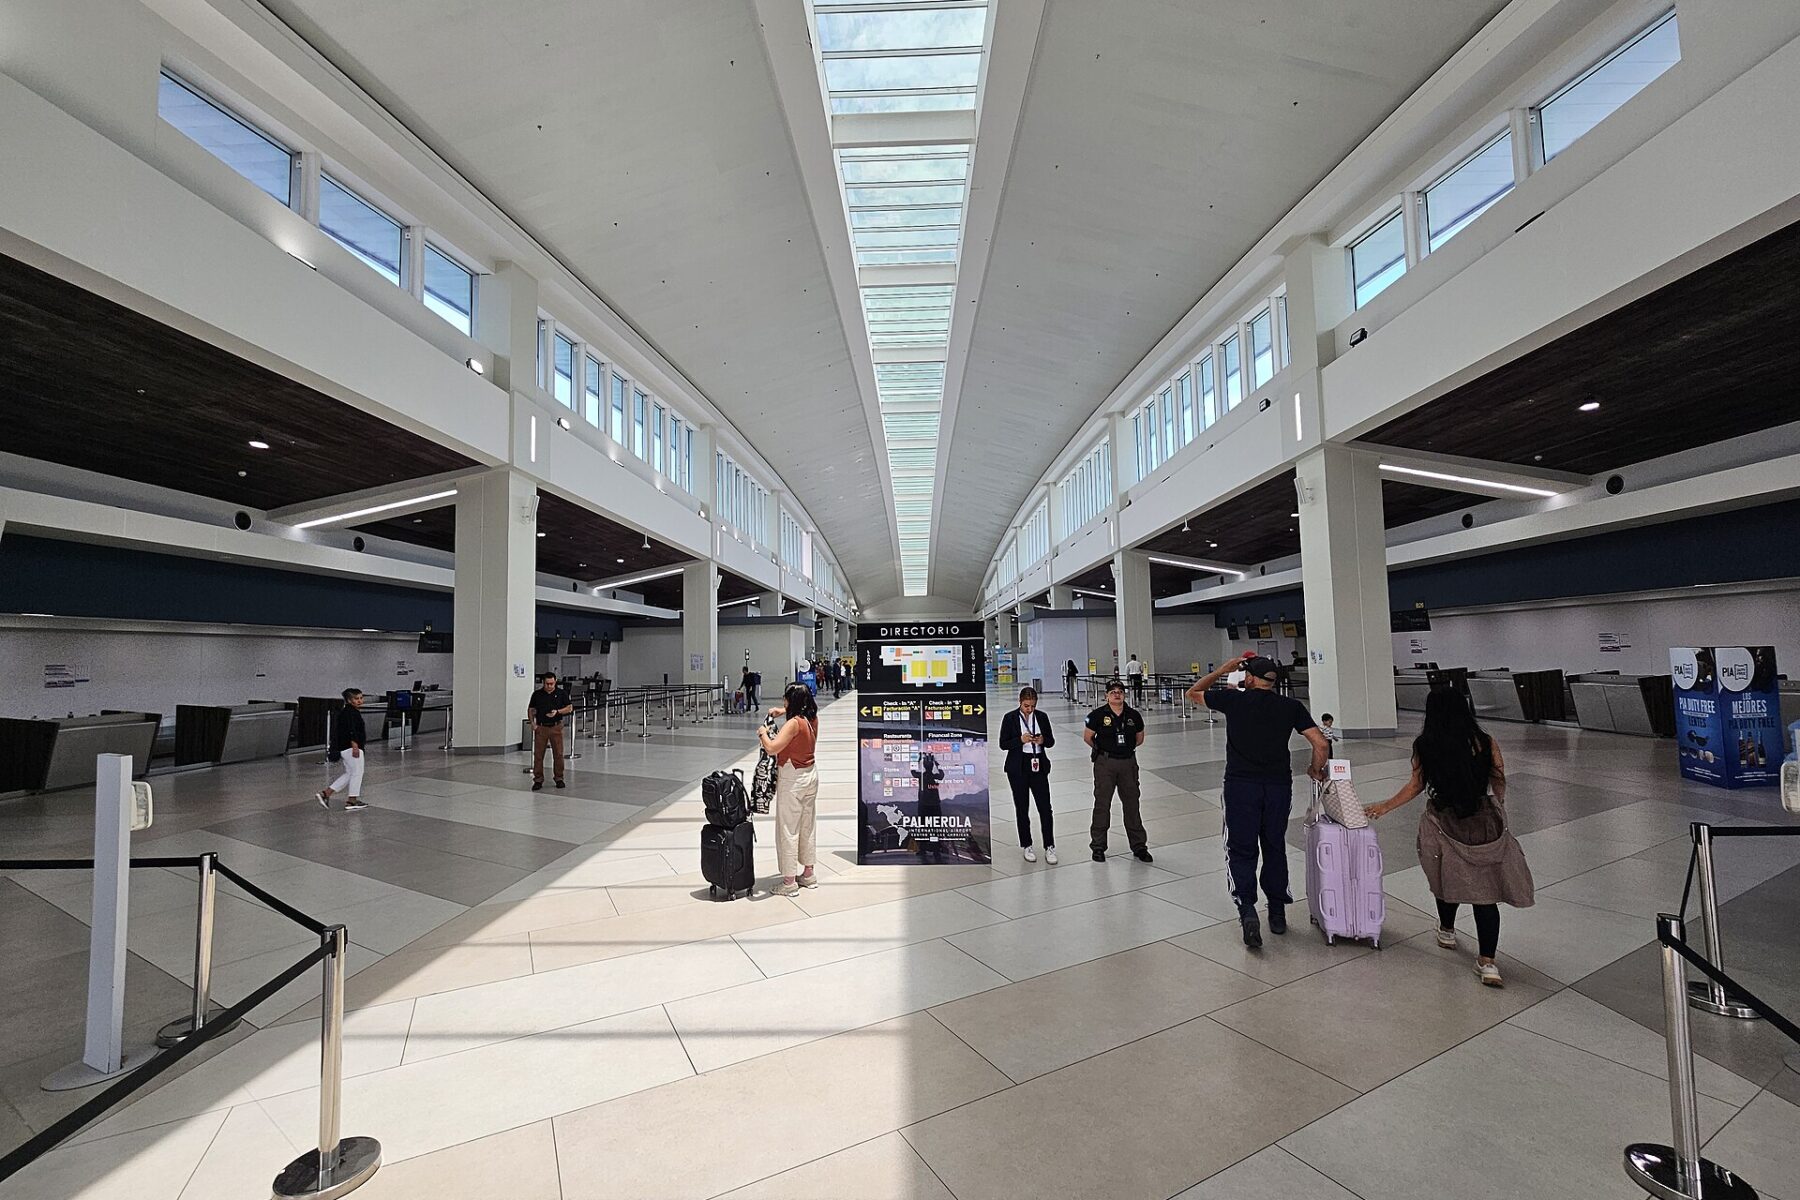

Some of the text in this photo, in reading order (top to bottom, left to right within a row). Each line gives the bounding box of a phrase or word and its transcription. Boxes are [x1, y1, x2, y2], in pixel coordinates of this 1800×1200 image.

[880, 626, 960, 636] DIRECTORIO
[1674, 665, 1683, 675] PIA
[1722, 667, 1735, 677] PIA
[1742, 692, 1751, 700] LOS
[1679, 697, 1715, 714] PIA DUTY FREE
[1732, 699, 1767, 714] MEJORES
[1758, 717, 1775, 728] FREE
[902, 816, 972, 828] PALMEROLA
